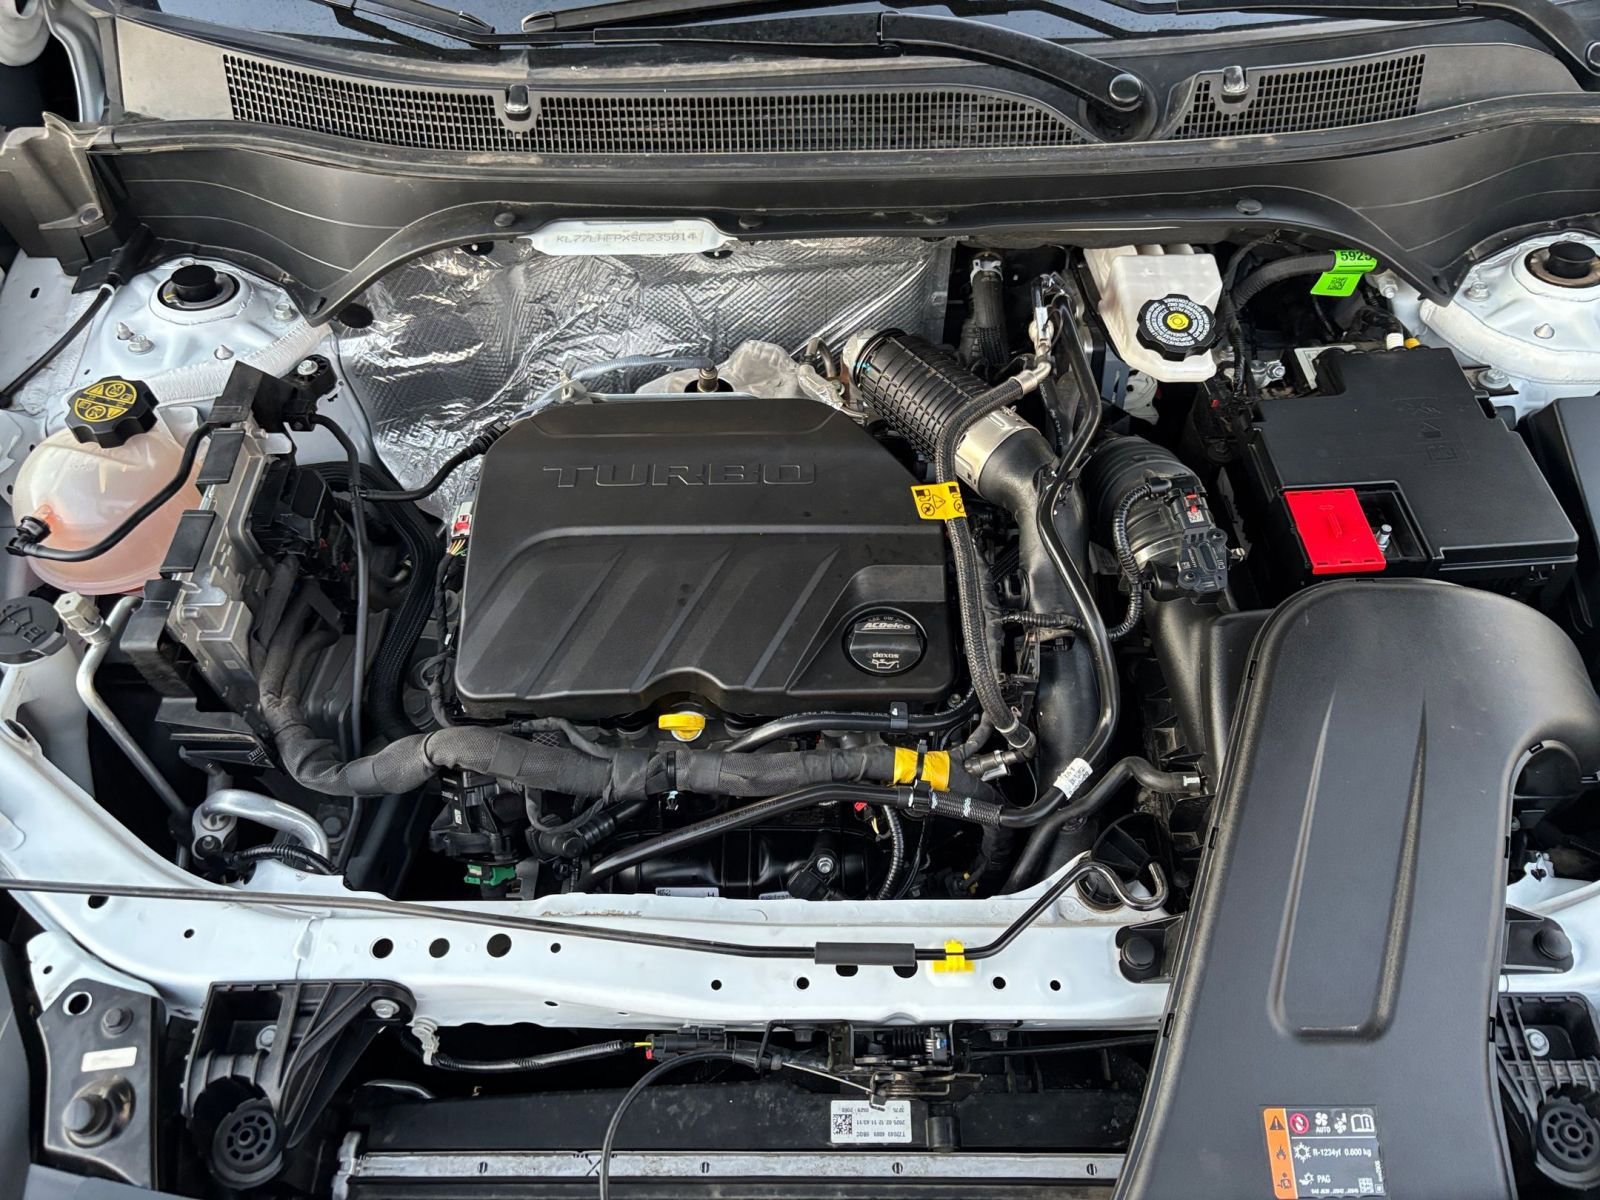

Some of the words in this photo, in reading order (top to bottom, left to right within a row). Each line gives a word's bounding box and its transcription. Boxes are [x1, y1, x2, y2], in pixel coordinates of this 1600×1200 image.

[542, 463, 817, 488] TURBO
[862, 622, 911, 630] ACDelco
[872, 651, 899, 659] dexos
[1363, 1148, 1372, 1157] kg
[1317, 1175, 1331, 1184] PAG
